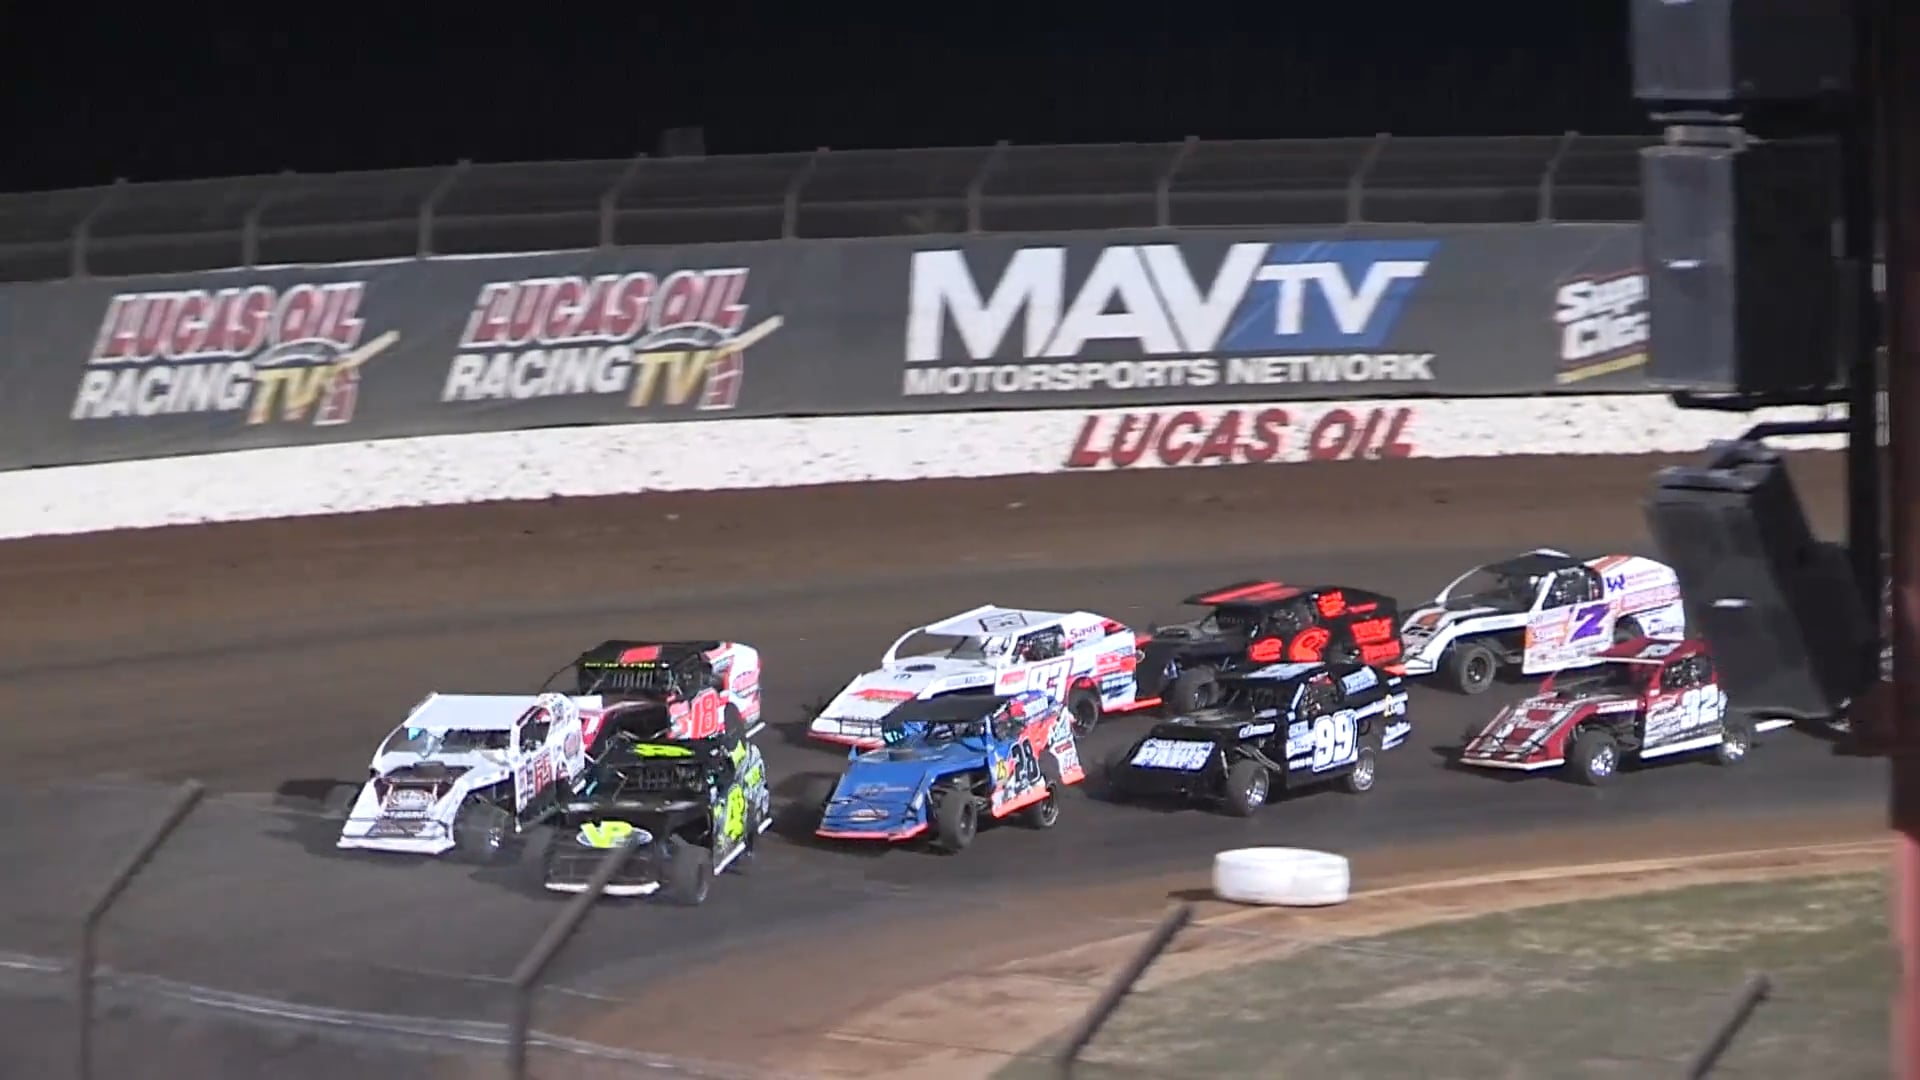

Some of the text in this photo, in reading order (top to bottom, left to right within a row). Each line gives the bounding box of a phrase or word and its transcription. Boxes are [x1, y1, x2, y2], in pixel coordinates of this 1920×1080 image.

[87, 280, 367, 365] LUCAS OIL
[457, 266, 750, 349] LUCAS OIL
[69, 360, 251, 421] RACING
[439, 346, 636, 403] RACING
[902, 352, 1437, 396] MOTORSPORTS NETWORK
[1064, 406, 1416, 469] LUCAS OIL
[1312, 709, 1358, 772] 99
